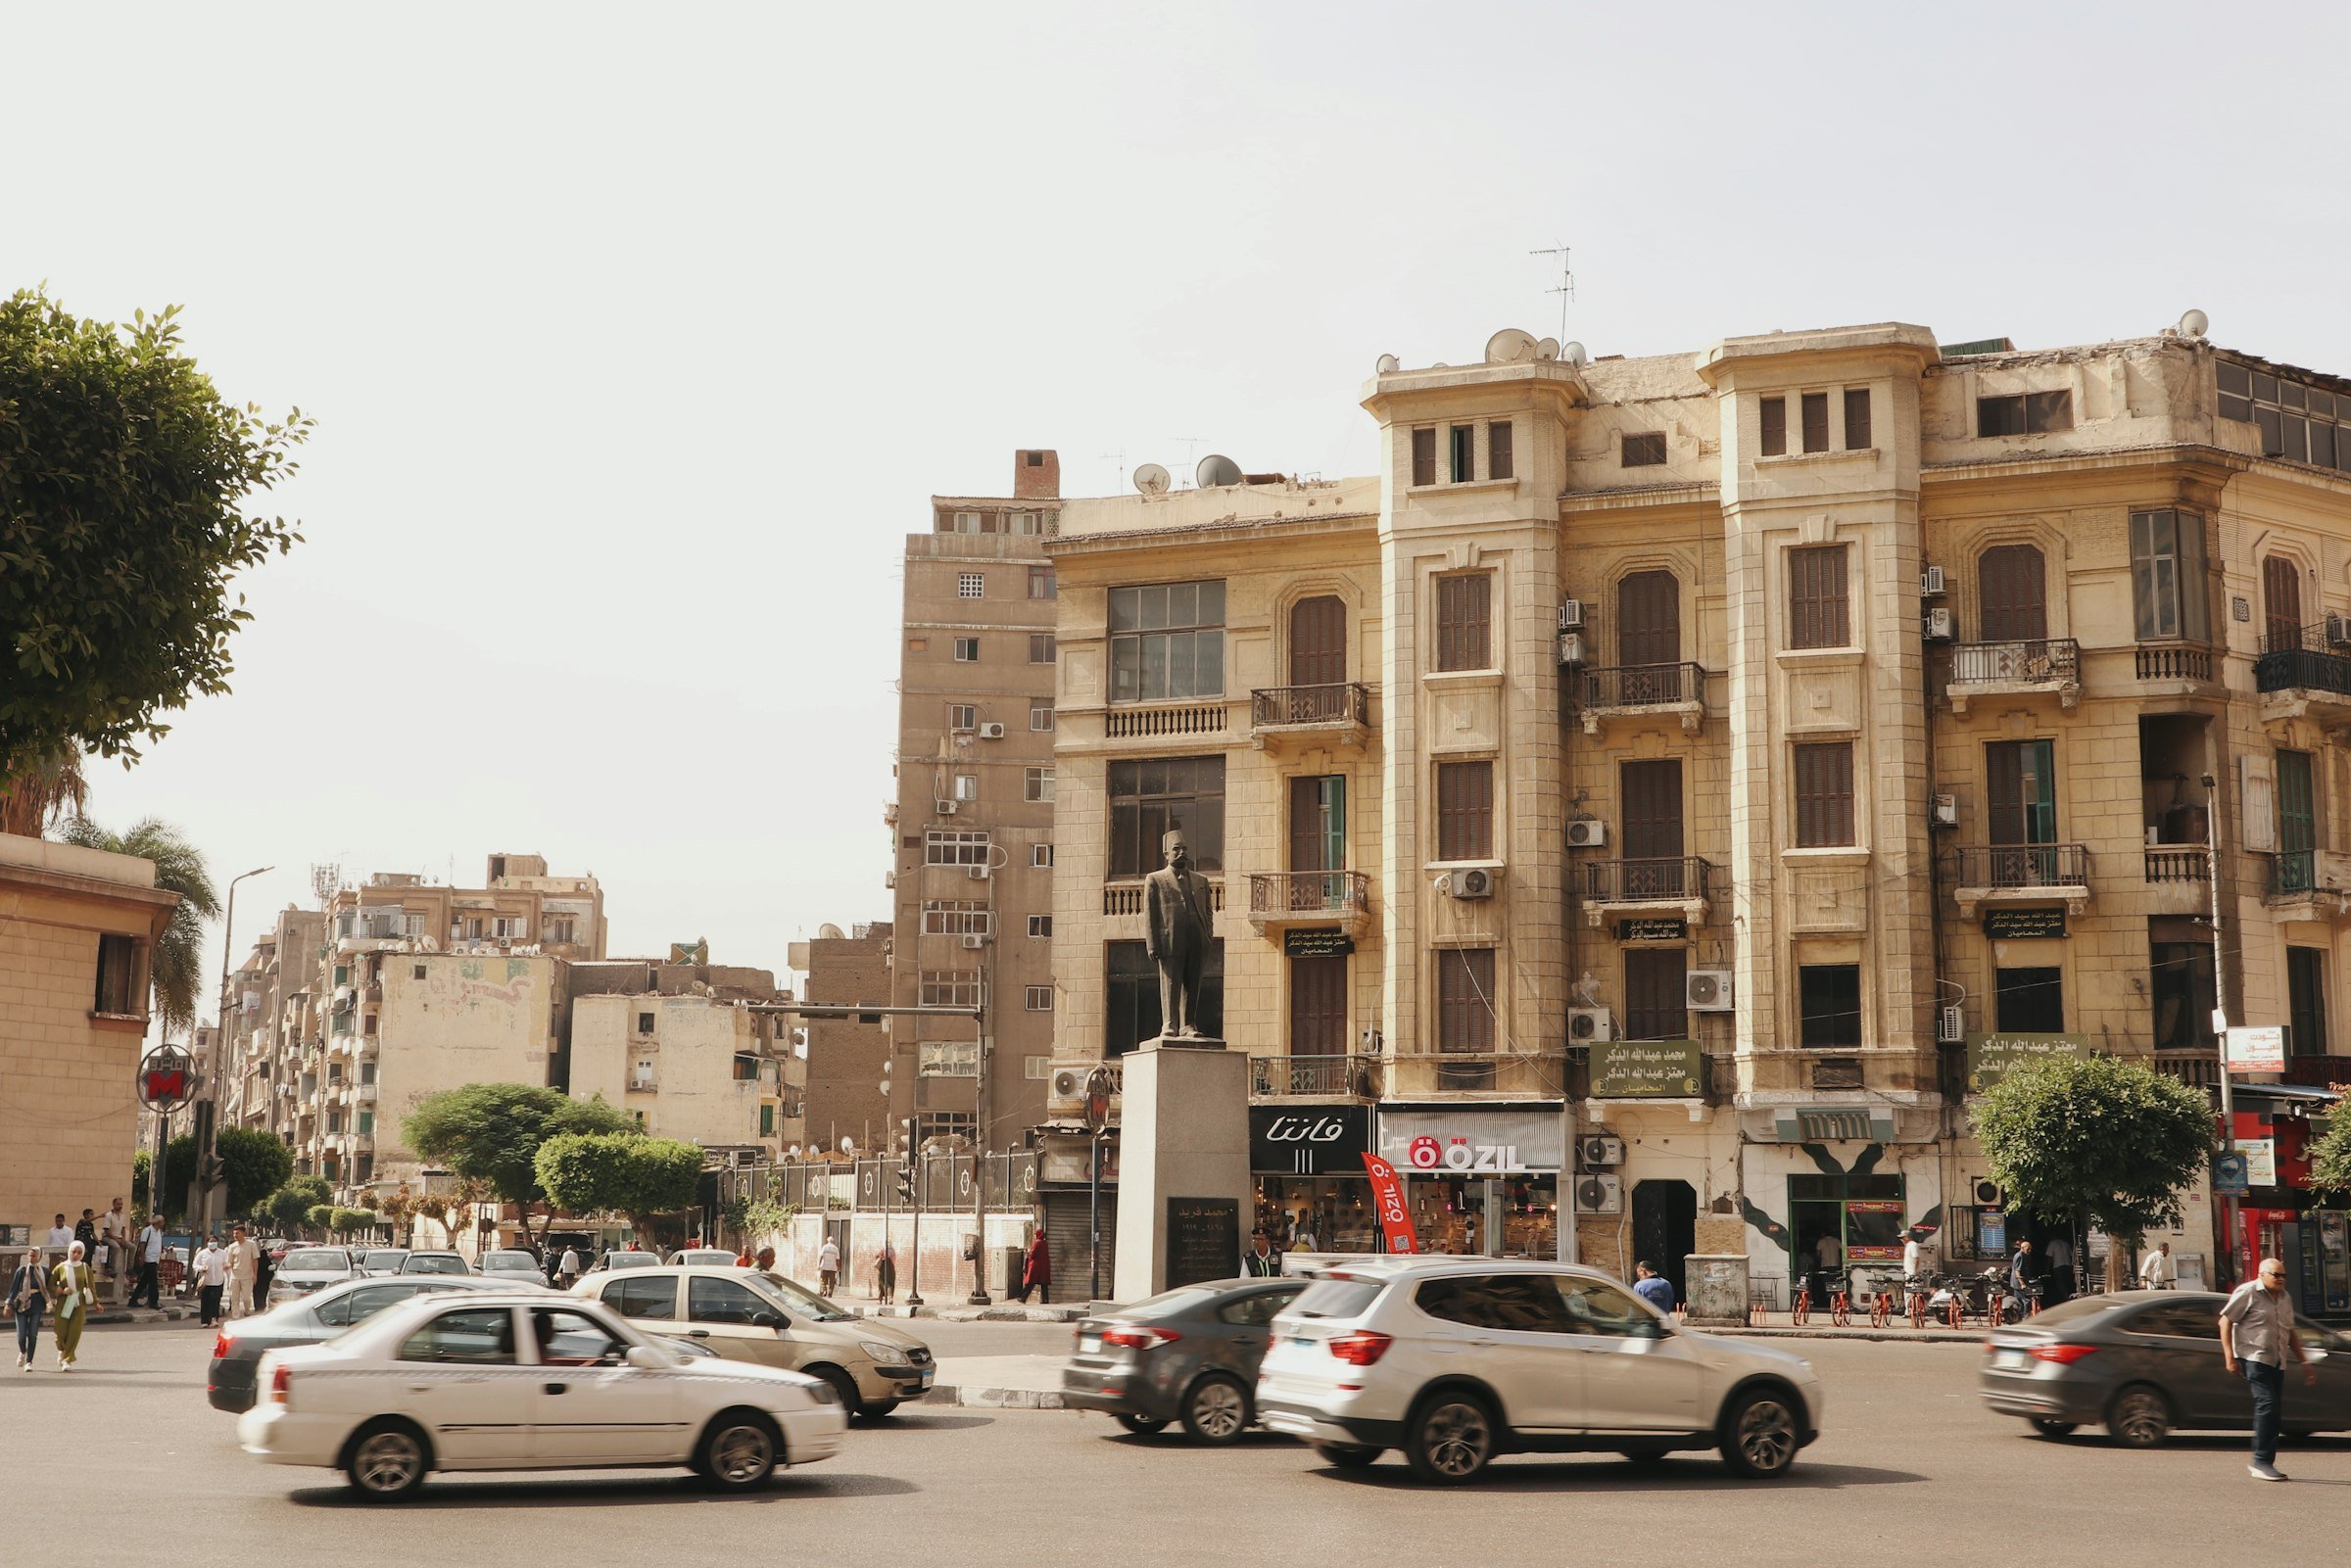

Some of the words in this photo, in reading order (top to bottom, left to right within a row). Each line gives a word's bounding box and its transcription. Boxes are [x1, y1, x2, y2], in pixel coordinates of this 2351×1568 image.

[1664, 1049, 1687, 1061] محمد
[2050, 1040, 2077, 1054] معتز
[148, 1070, 184, 1098] M
[1665, 1067, 1687, 1081] معتز
[1621, 1083, 1665, 1094] المحاميان
[1266, 1116, 1343, 1142] فانتا
[1445, 1136, 1526, 1170] ÖZIL
[1383, 1183, 1405, 1223] ÖZIL
